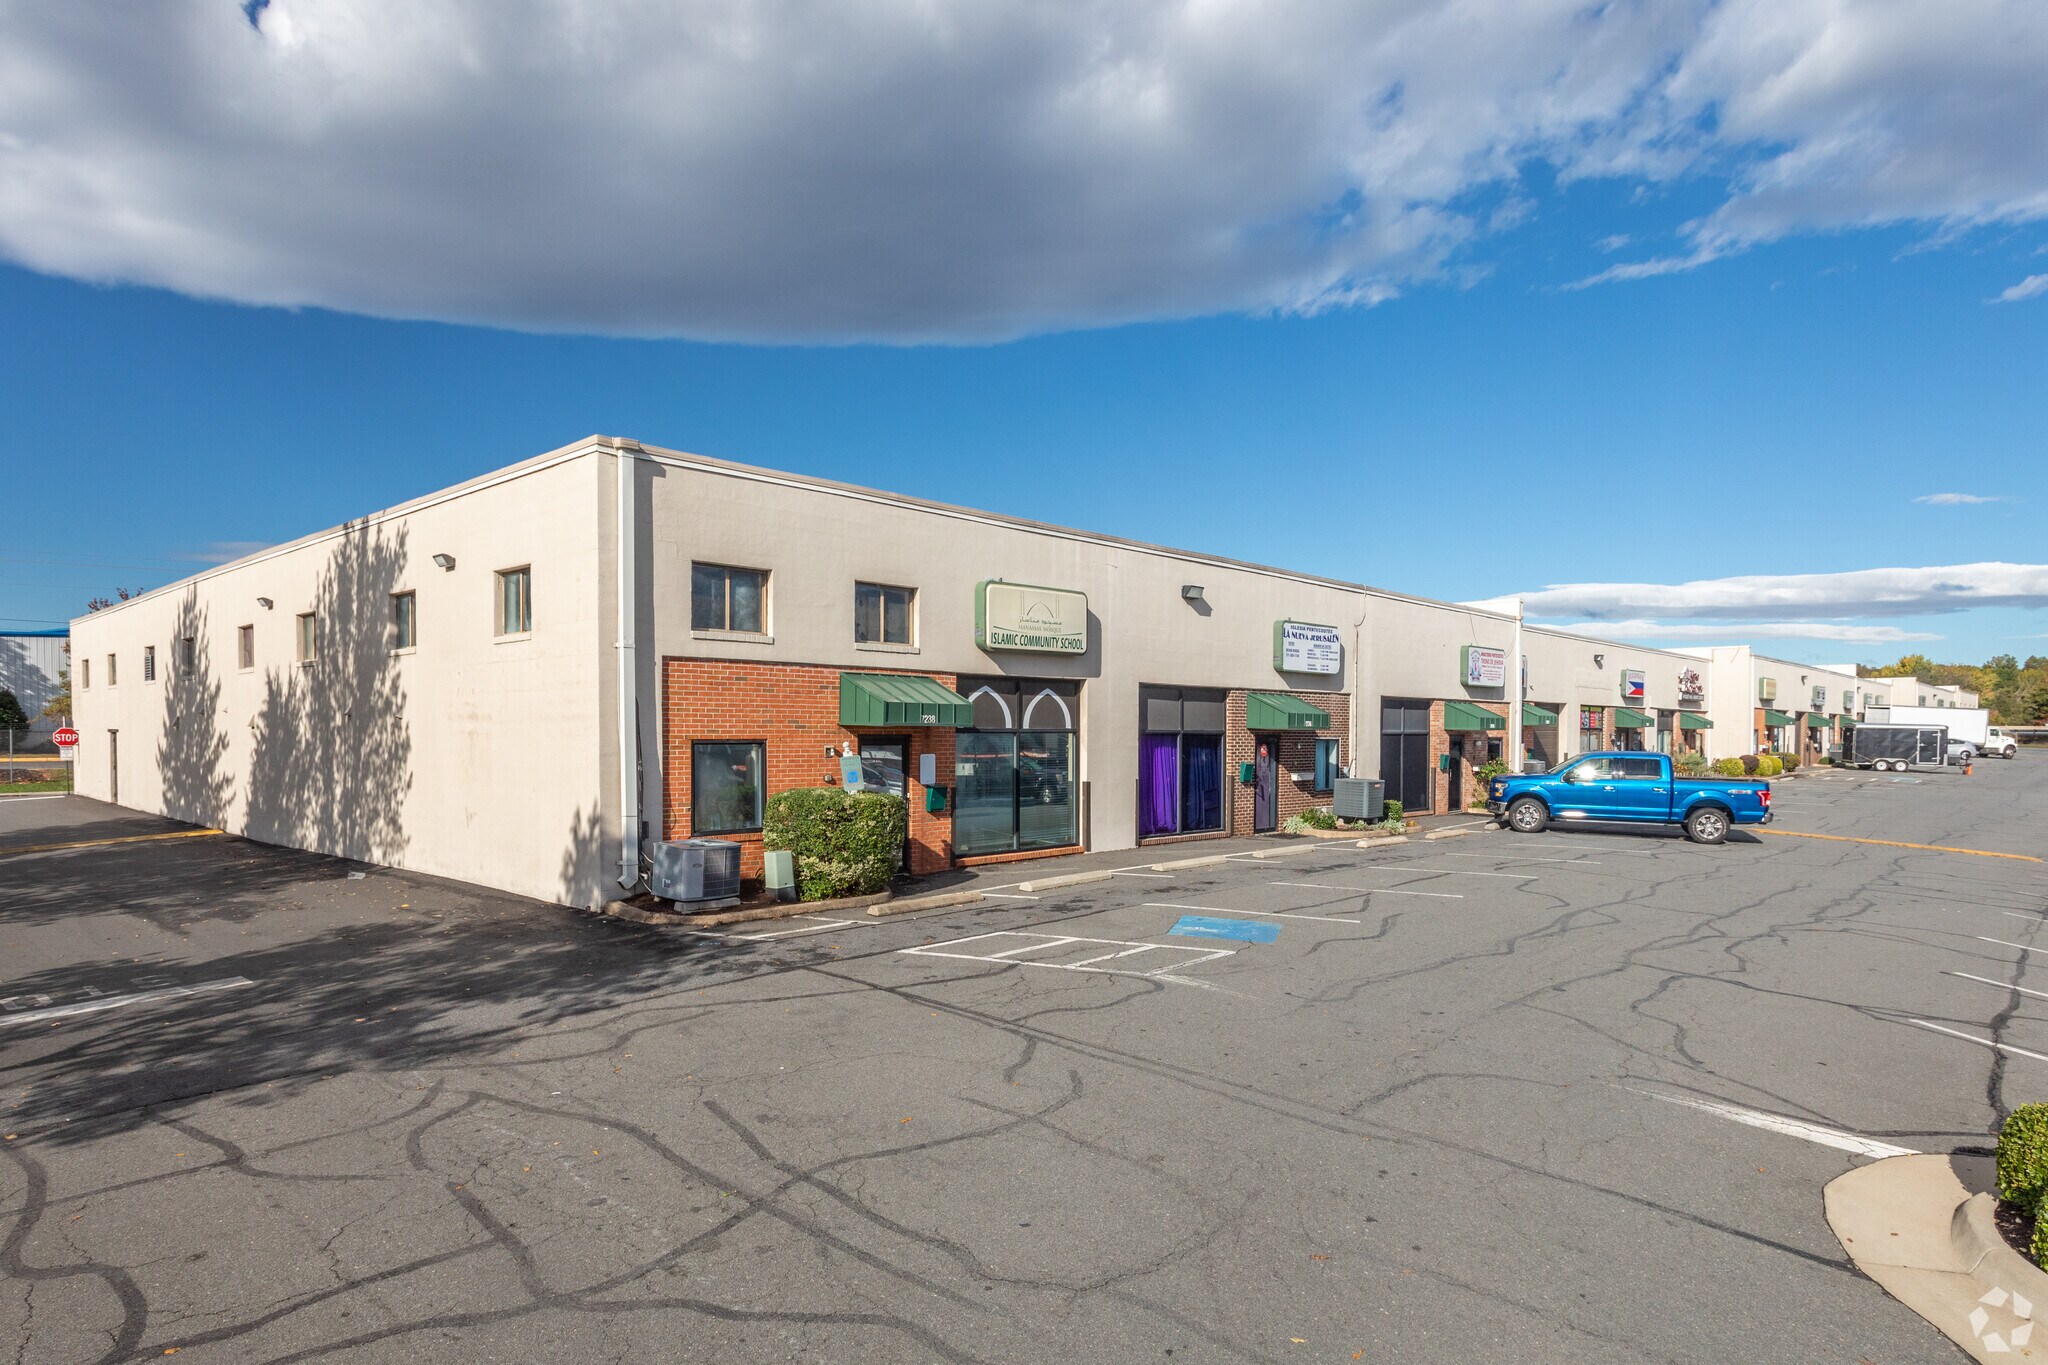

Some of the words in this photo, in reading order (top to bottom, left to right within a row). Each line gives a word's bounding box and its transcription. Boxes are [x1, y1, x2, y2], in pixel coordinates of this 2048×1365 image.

[1283, 627, 1290, 639] LA
[1291, 630, 1309, 640] NUEVA
[990, 632, 1018, 646] ISLAMIC
[1020, 634, 1060, 649] COMMUNITY
[1060, 637, 1084, 650] SCHOOL
[55, 733, 78, 742] STOP
